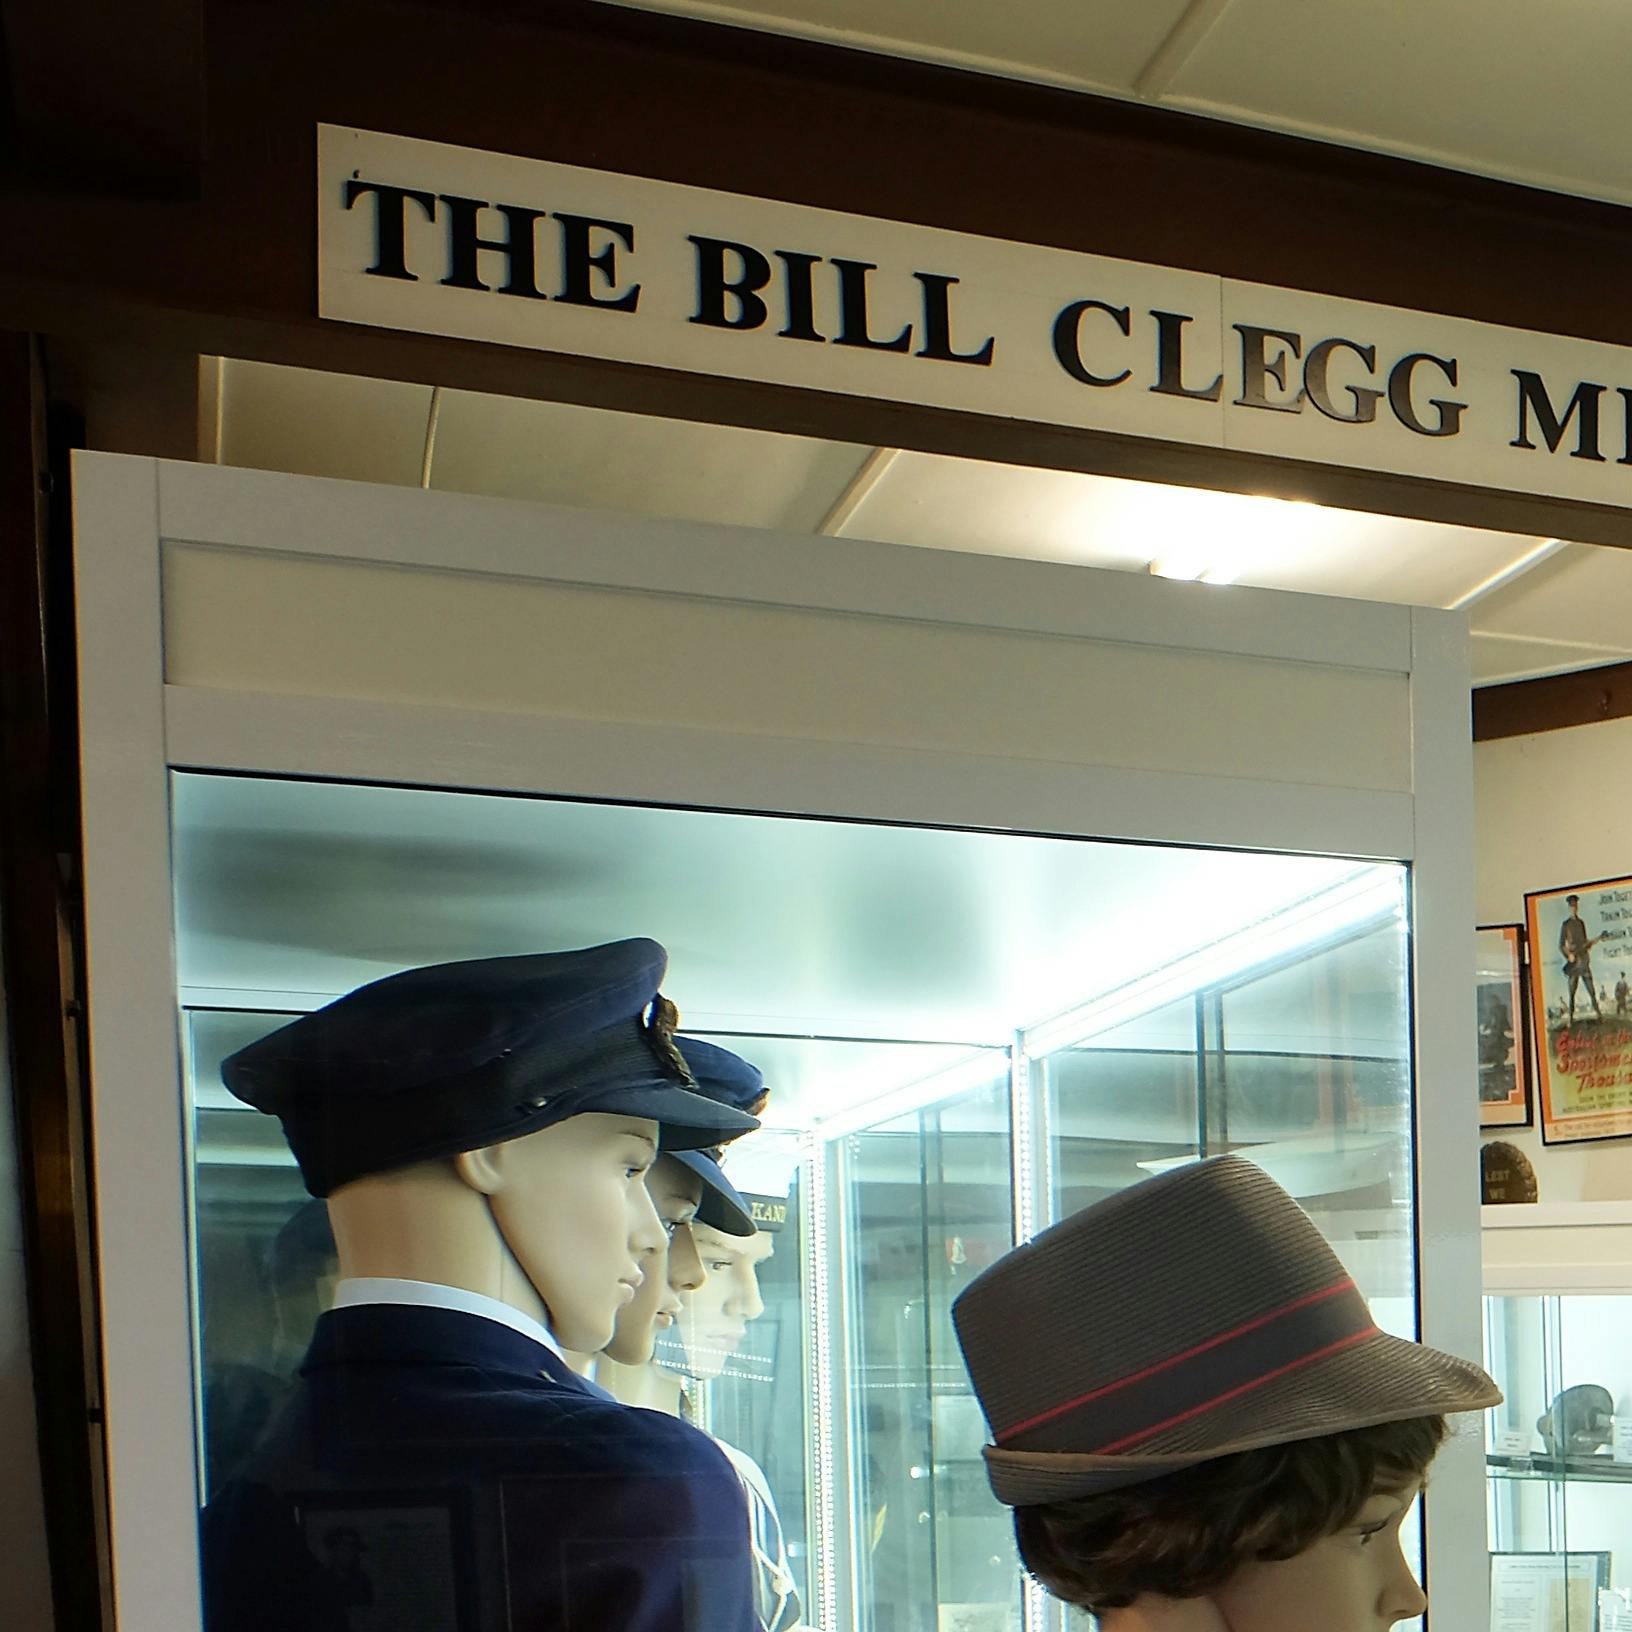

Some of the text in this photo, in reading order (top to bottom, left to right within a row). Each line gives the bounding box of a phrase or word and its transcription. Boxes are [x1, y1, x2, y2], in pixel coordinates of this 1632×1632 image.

[345, 179, 640, 315] THE
[688, 234, 997, 366] BILL
[1052, 298, 1468, 438] CLEGG
